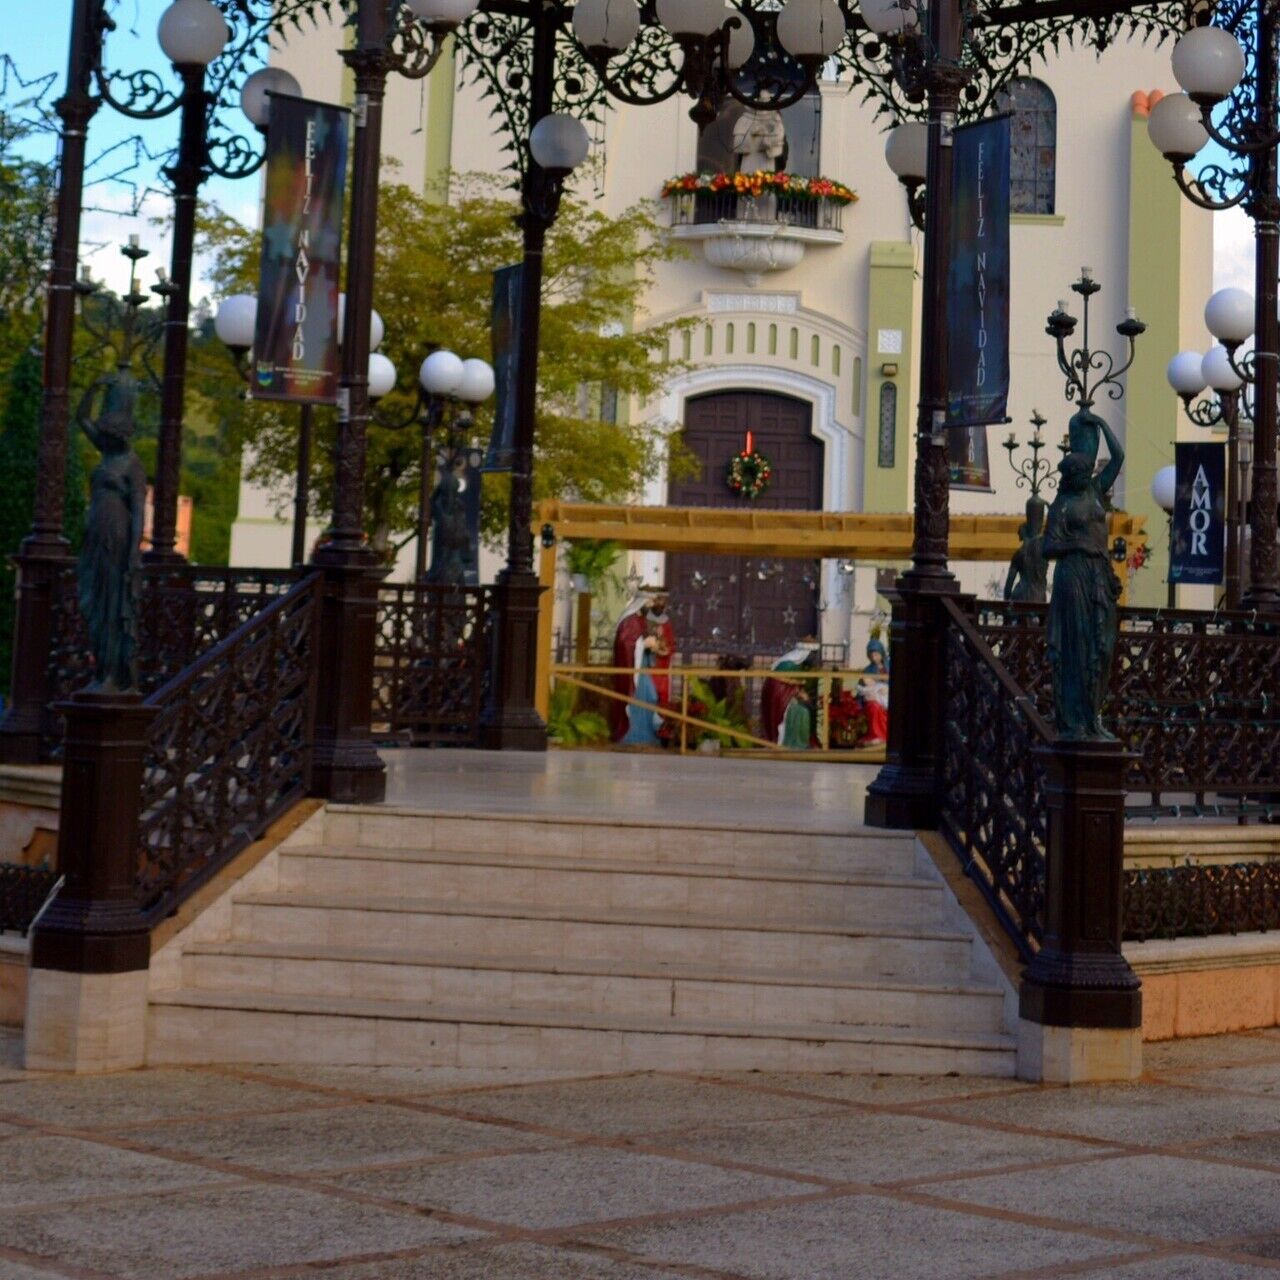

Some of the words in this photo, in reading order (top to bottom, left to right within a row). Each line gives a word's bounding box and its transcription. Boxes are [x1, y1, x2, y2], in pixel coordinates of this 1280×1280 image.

[302, 120, 317, 215] FELIZ
[976, 142, 985, 238] FELIZ
[291, 229, 311, 361] NAVIDAD
[976, 251, 987, 388] NAVIDAD
[1189, 462, 1213, 556] AMOR
